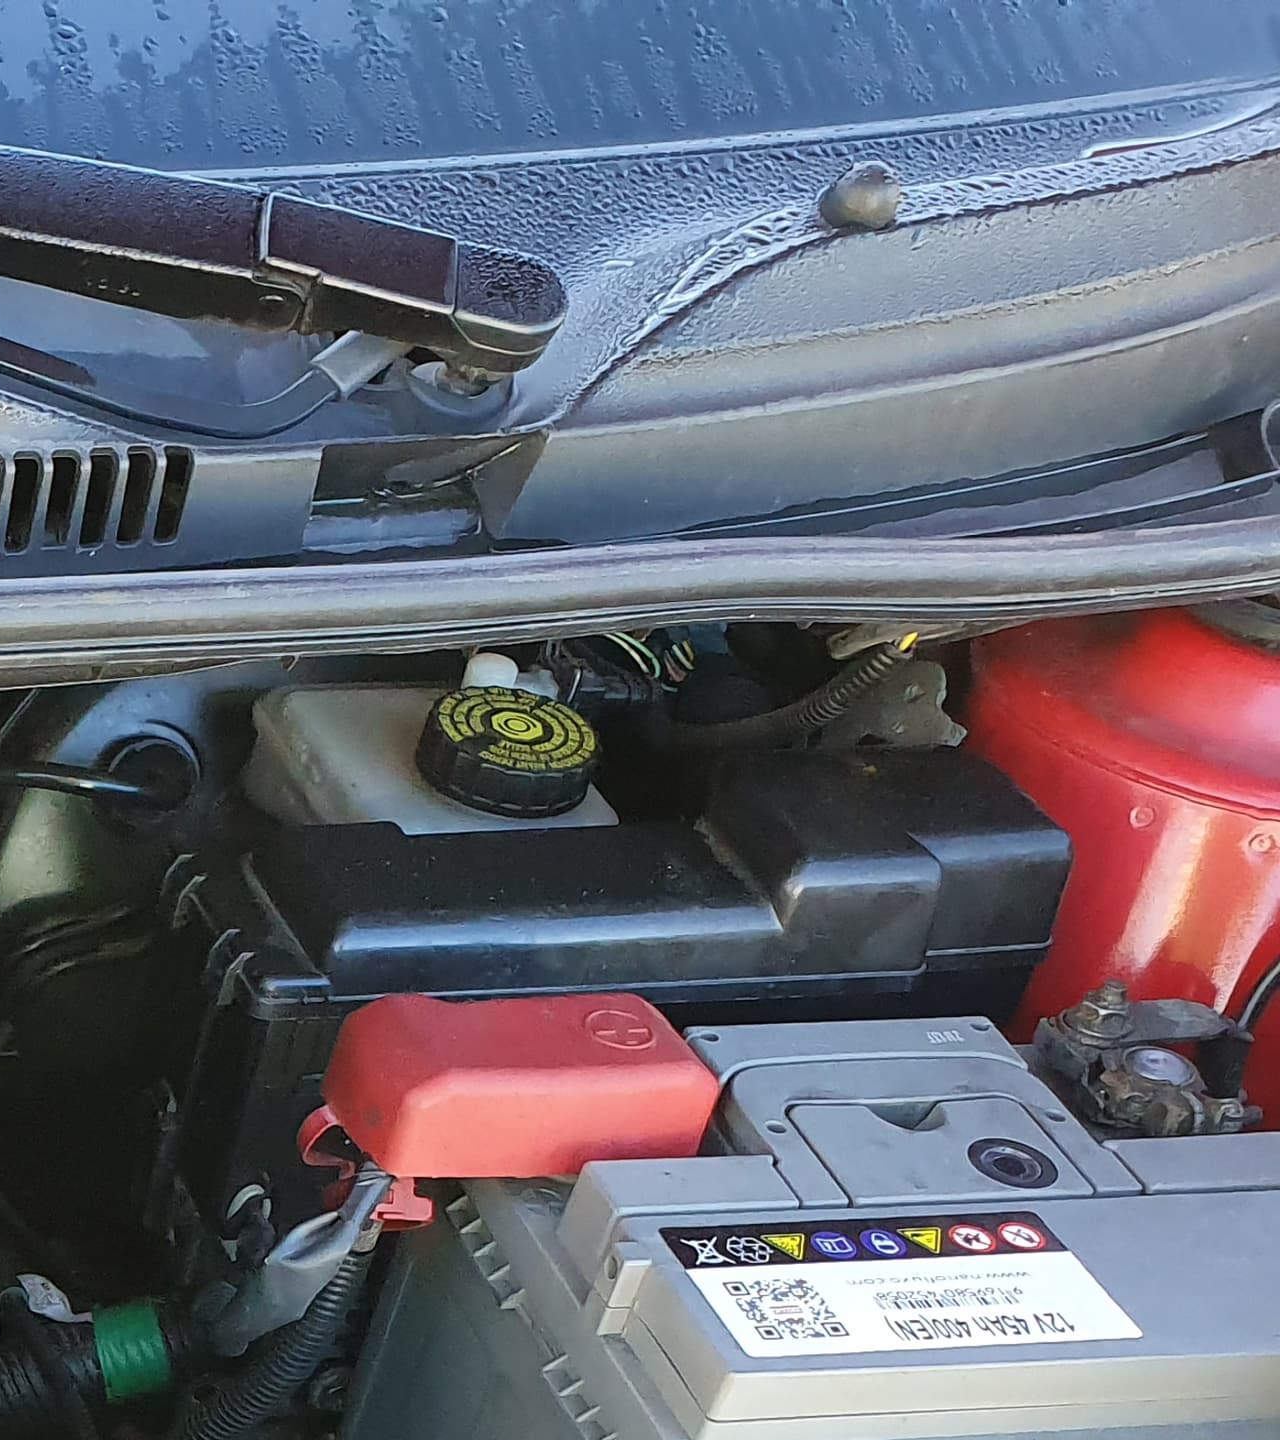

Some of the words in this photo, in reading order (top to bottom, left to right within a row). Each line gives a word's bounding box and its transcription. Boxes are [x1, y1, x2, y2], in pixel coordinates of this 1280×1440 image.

[882, 1315, 972, 1342] 400(EN)
[971, 1313, 1032, 1337] 45Ah
[1032, 1311, 1076, 1334] 12V
